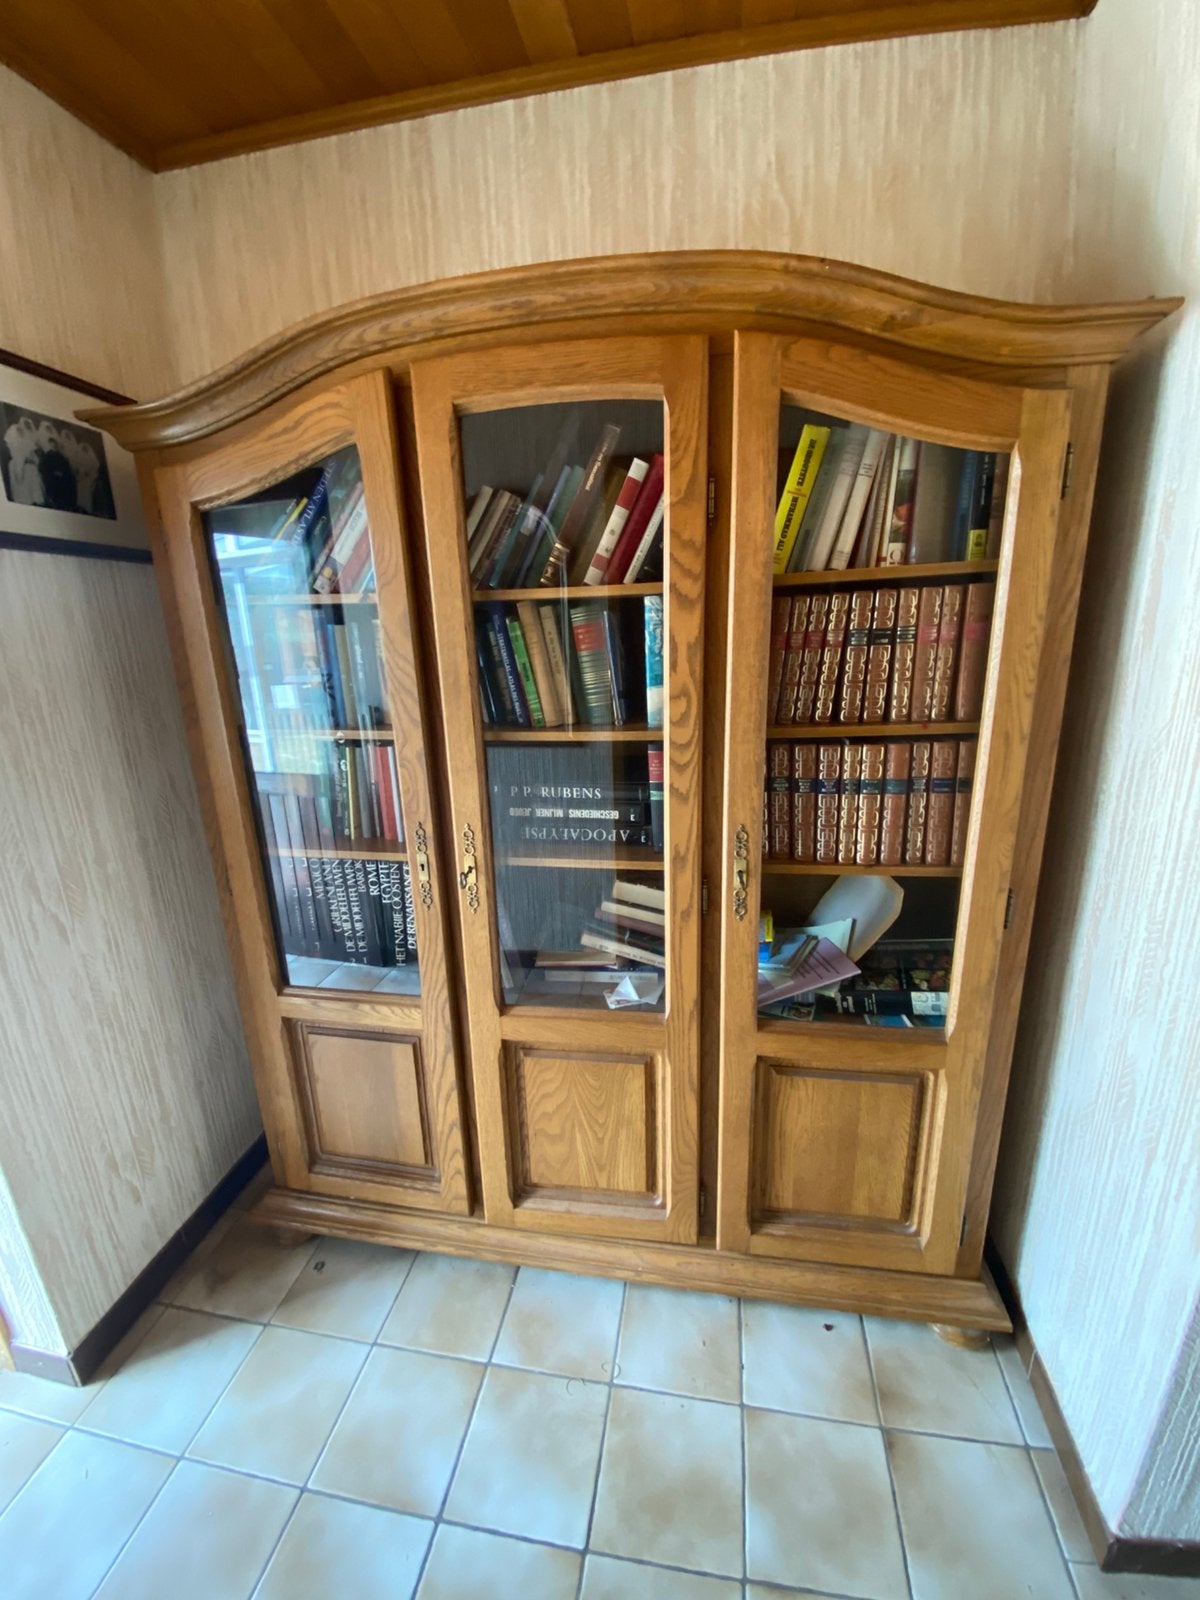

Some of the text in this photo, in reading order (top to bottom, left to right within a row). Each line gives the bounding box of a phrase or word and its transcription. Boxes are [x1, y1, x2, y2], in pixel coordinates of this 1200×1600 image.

[295, 500, 316, 534] ATLAS
[535, 808, 563, 819] MIJNER
[541, 786, 602, 799] RUBENS
[568, 809, 620, 820] GESCHIEDENIS
[309, 858, 326, 900] MEXICO
[322, 858, 343, 933] GRIEKENLAND
[354, 860, 367, 892] BAROK
[365, 860, 380, 896] ROME
[378, 860, 392, 903] EGYPTE
[332, 859, 356, 952] DE MIDDELEEUWEN
[344, 859, 368, 952] DE MIDDELEEUWEN
[389, 863, 406, 966] HET NABIJE OOSTEN
[403, 863, 417, 949] DE RENAISSANCE
